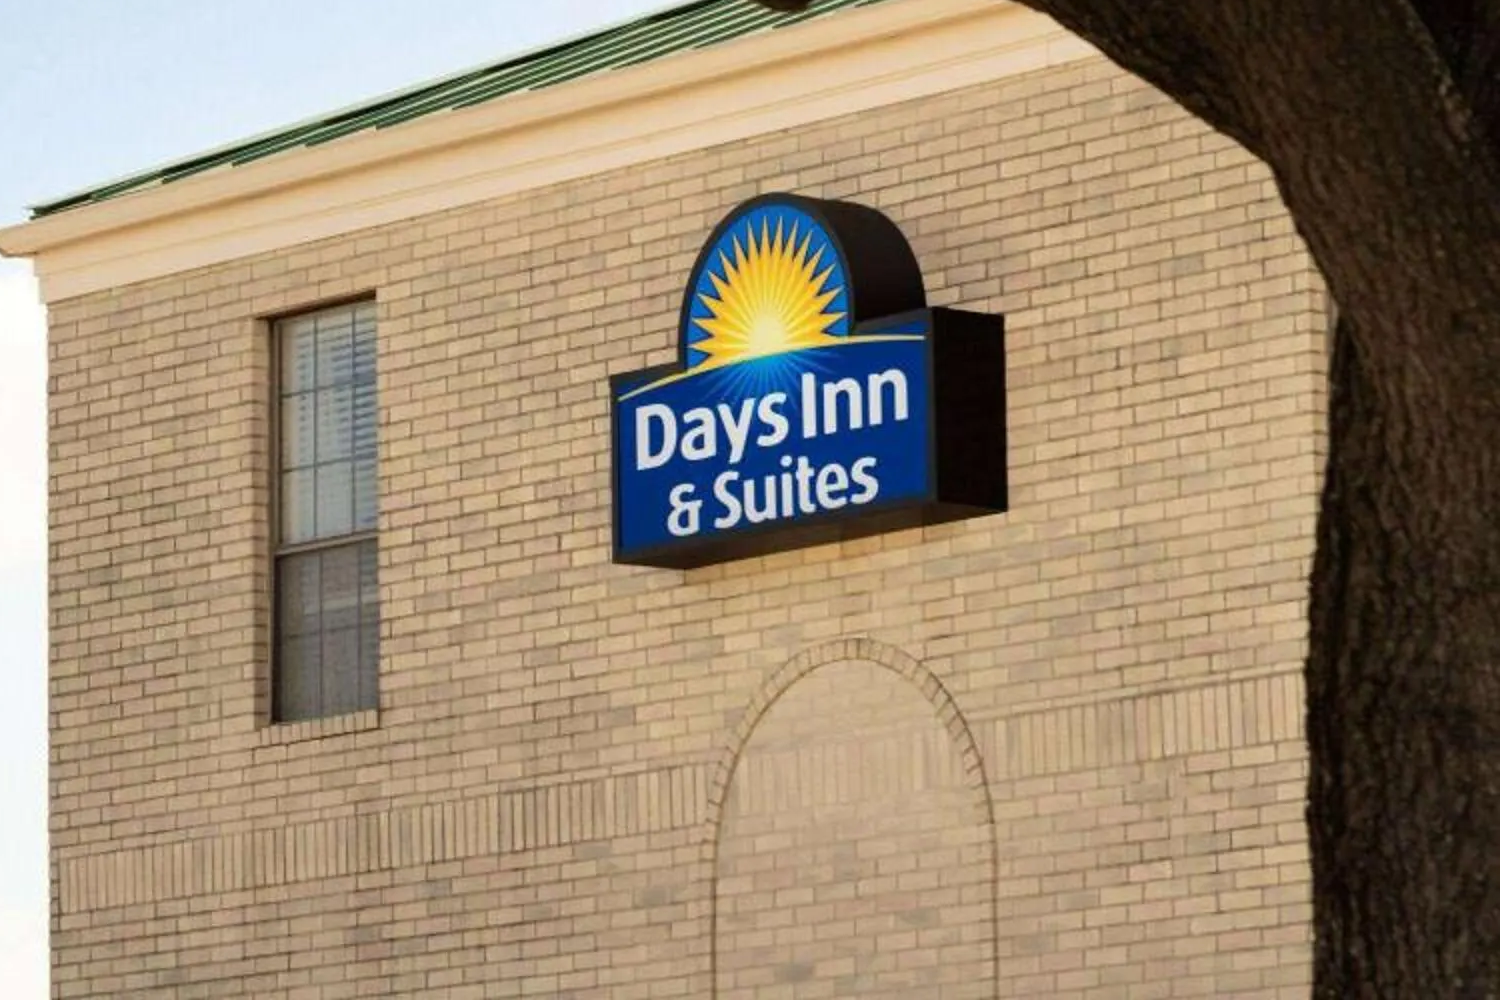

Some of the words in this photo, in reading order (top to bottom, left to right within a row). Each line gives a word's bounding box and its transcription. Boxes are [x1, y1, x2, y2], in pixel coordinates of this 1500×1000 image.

[635, 392, 790, 471] Days
[801, 369, 909, 439] Inn
[667, 483, 703, 537] &
[713, 455, 880, 530] Suites
